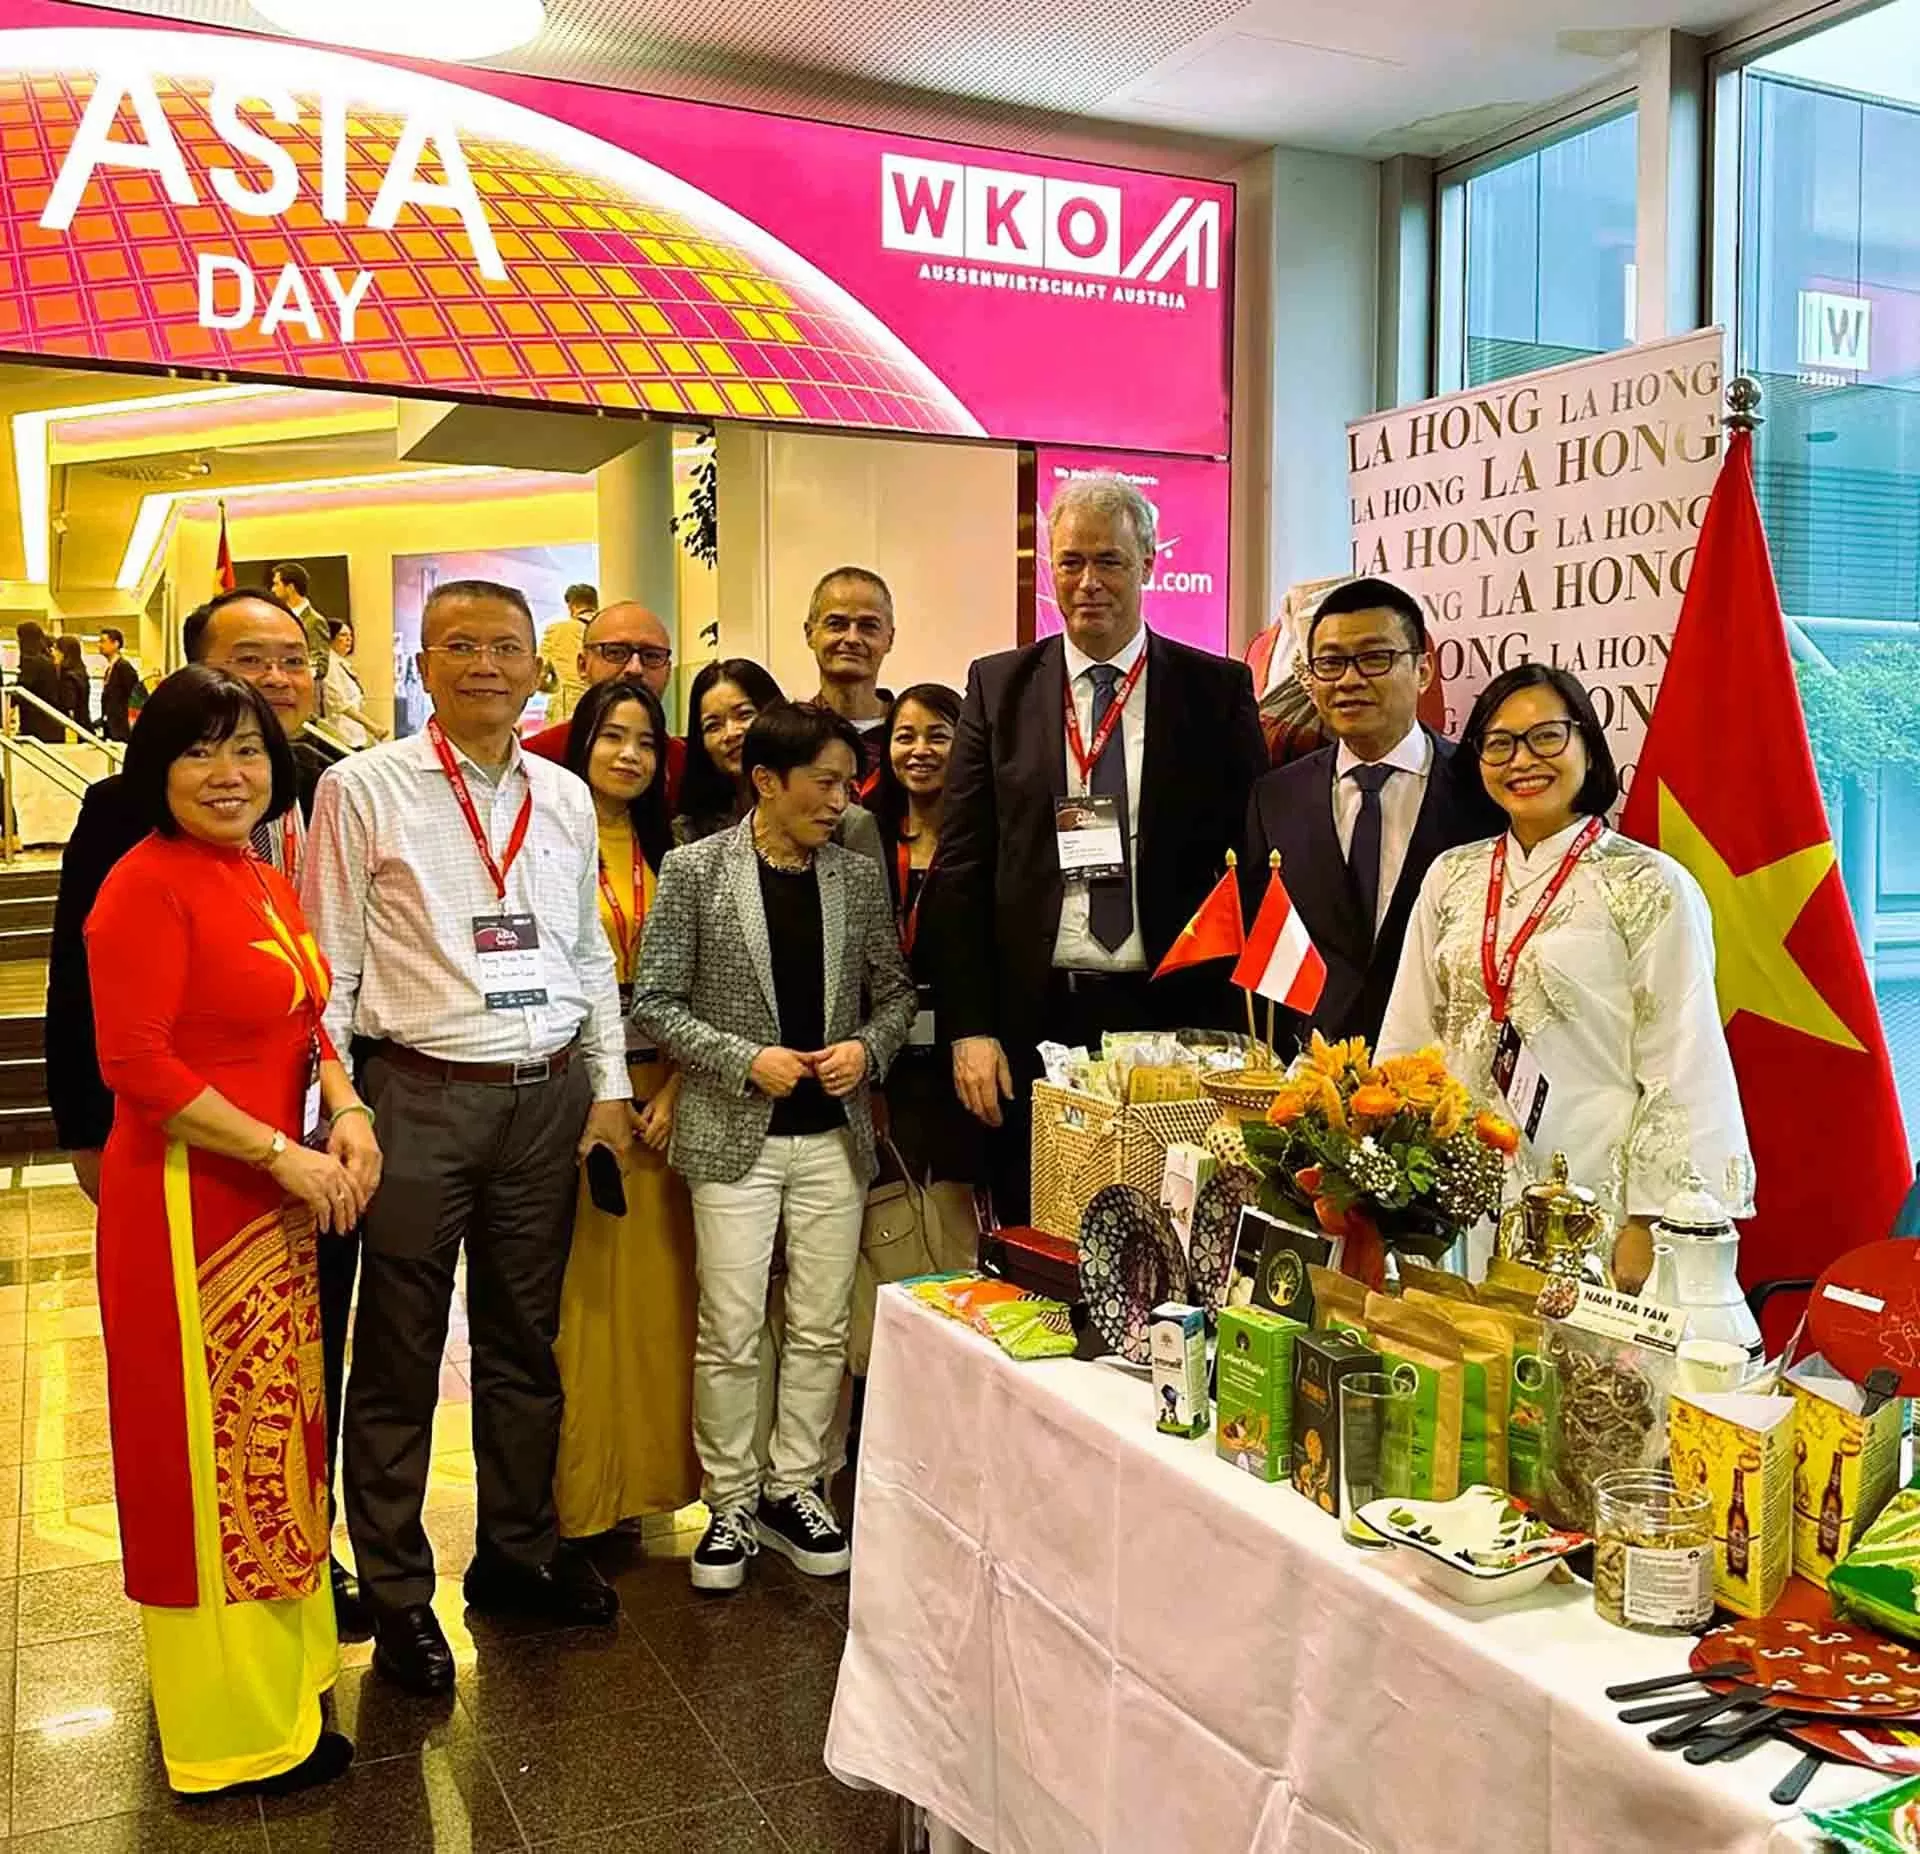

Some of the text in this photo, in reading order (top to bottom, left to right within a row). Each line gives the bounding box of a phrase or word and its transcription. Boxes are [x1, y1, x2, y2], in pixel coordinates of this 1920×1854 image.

[39, 68, 508, 281] ASIA
[892, 171, 1108, 259] WKO
[198, 253, 374, 343] DAY
[919, 263, 1187, 309] AUSSENWIRTSCHAFT AUSTRIA
[1348, 360, 1720, 473] LA HONG LA HONG
[1351, 413, 1721, 525] LA HONG LA HONG
[1403, 509, 1539, 570] HONG
[1556, 513, 1594, 549] LA
[1422, 591, 1463, 622] NG
[1478, 570, 1536, 617] LA
[1438, 632, 1676, 680] ONG LA HON
[1588, 683, 1657, 731] ON
